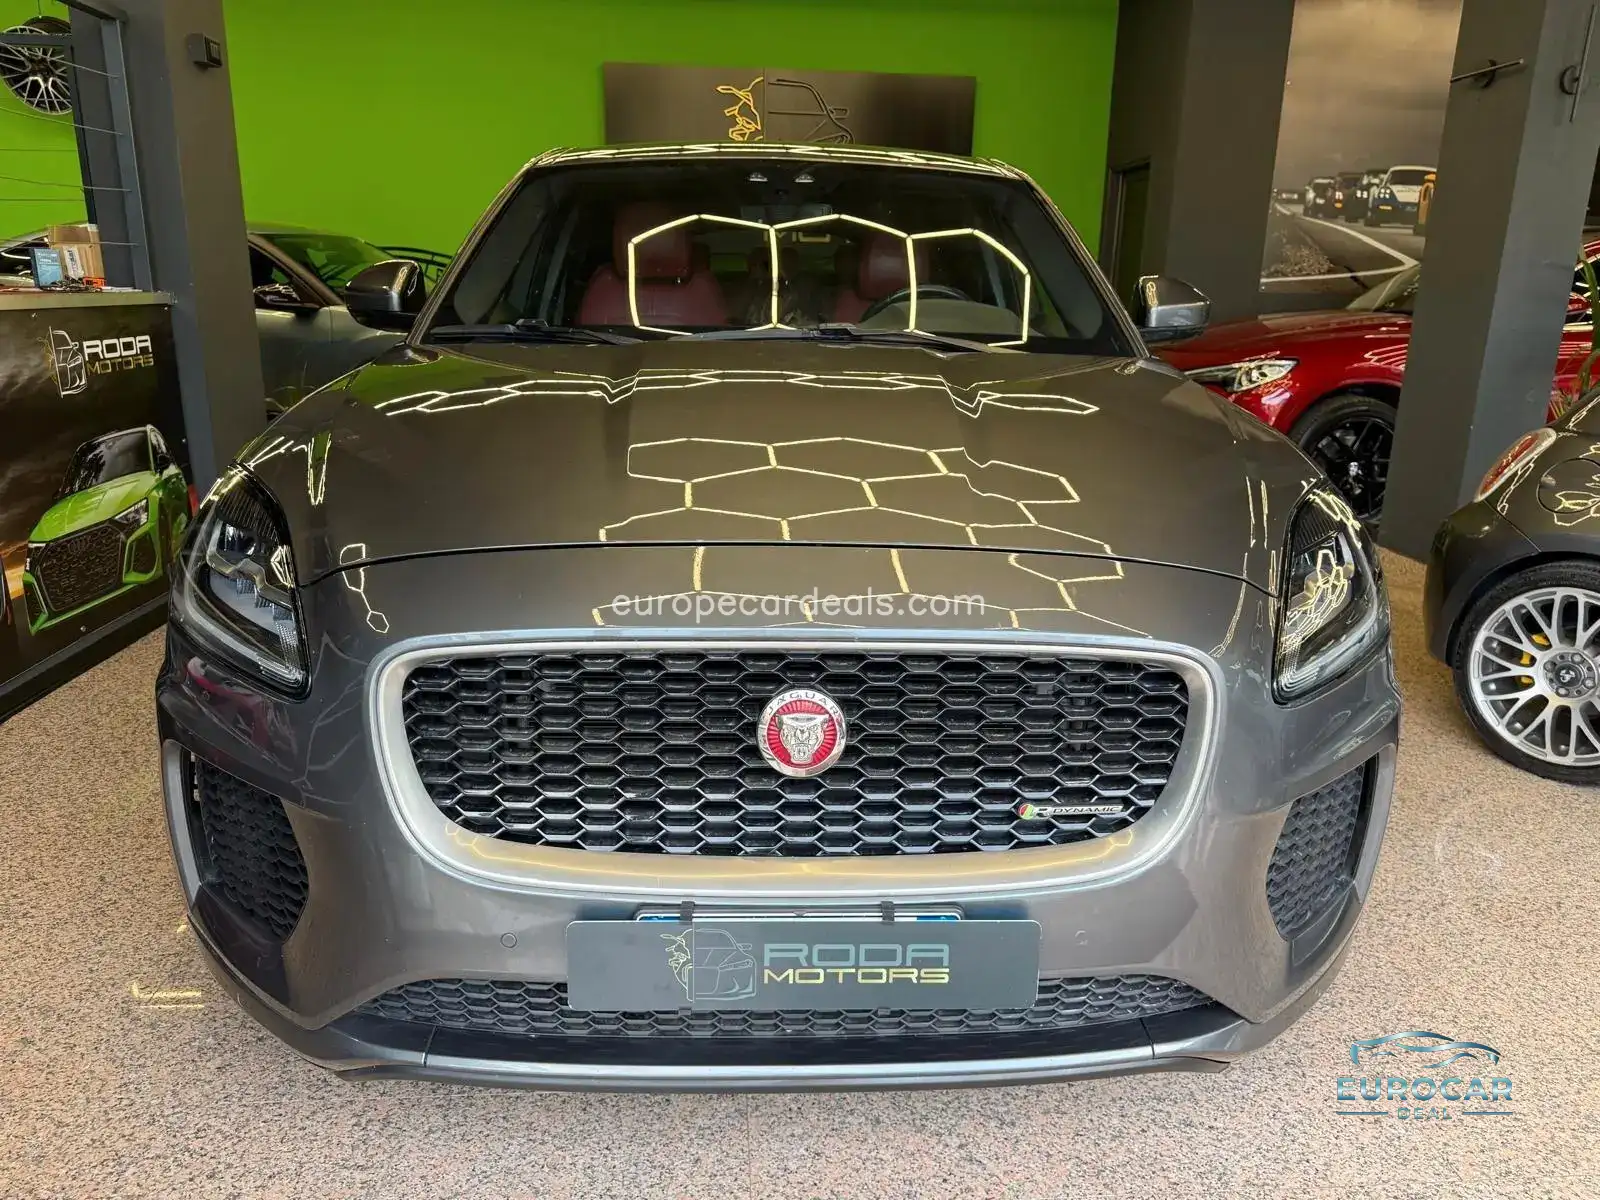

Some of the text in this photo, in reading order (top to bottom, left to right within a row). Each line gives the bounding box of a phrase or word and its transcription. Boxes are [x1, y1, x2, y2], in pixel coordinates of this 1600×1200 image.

[83, 335, 152, 361] RODA
[86, 354, 154, 376] MOTORS
[768, 691, 840, 717] JAGUAR
[763, 943, 950, 966] RODA
[763, 967, 950, 984] MOTORS
